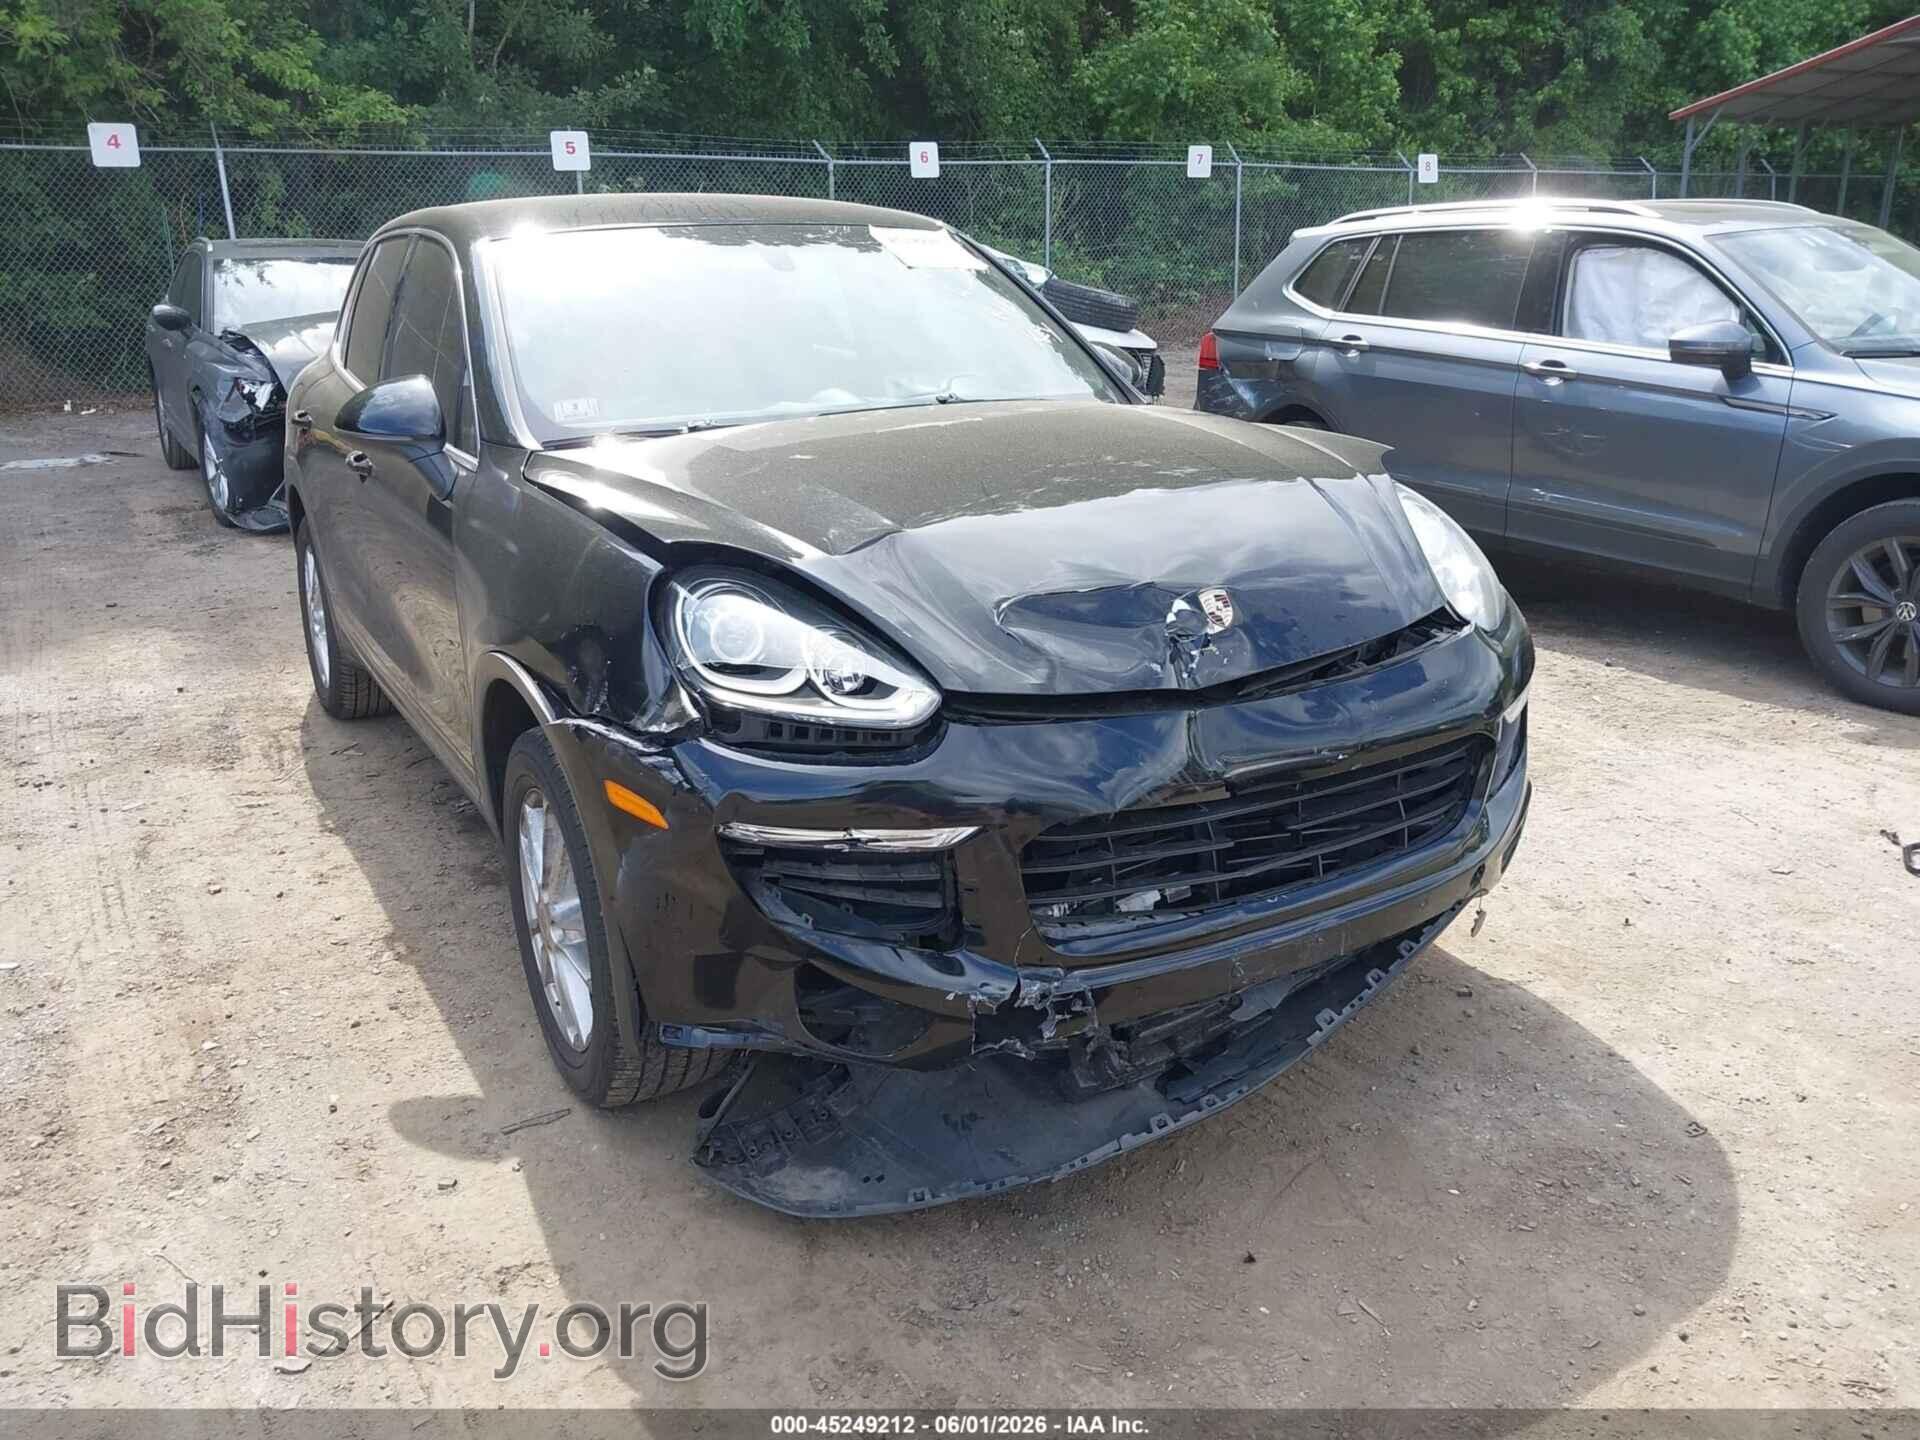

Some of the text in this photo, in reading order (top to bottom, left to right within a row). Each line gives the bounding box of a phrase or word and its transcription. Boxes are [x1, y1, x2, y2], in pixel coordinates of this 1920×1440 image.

[106, 134, 121, 149] 4
[565, 141, 576, 155] 5
[920, 151, 929, 164] 6
[1196, 153, 1204, 165] 7
[1424, 160, 1432, 172] 8
